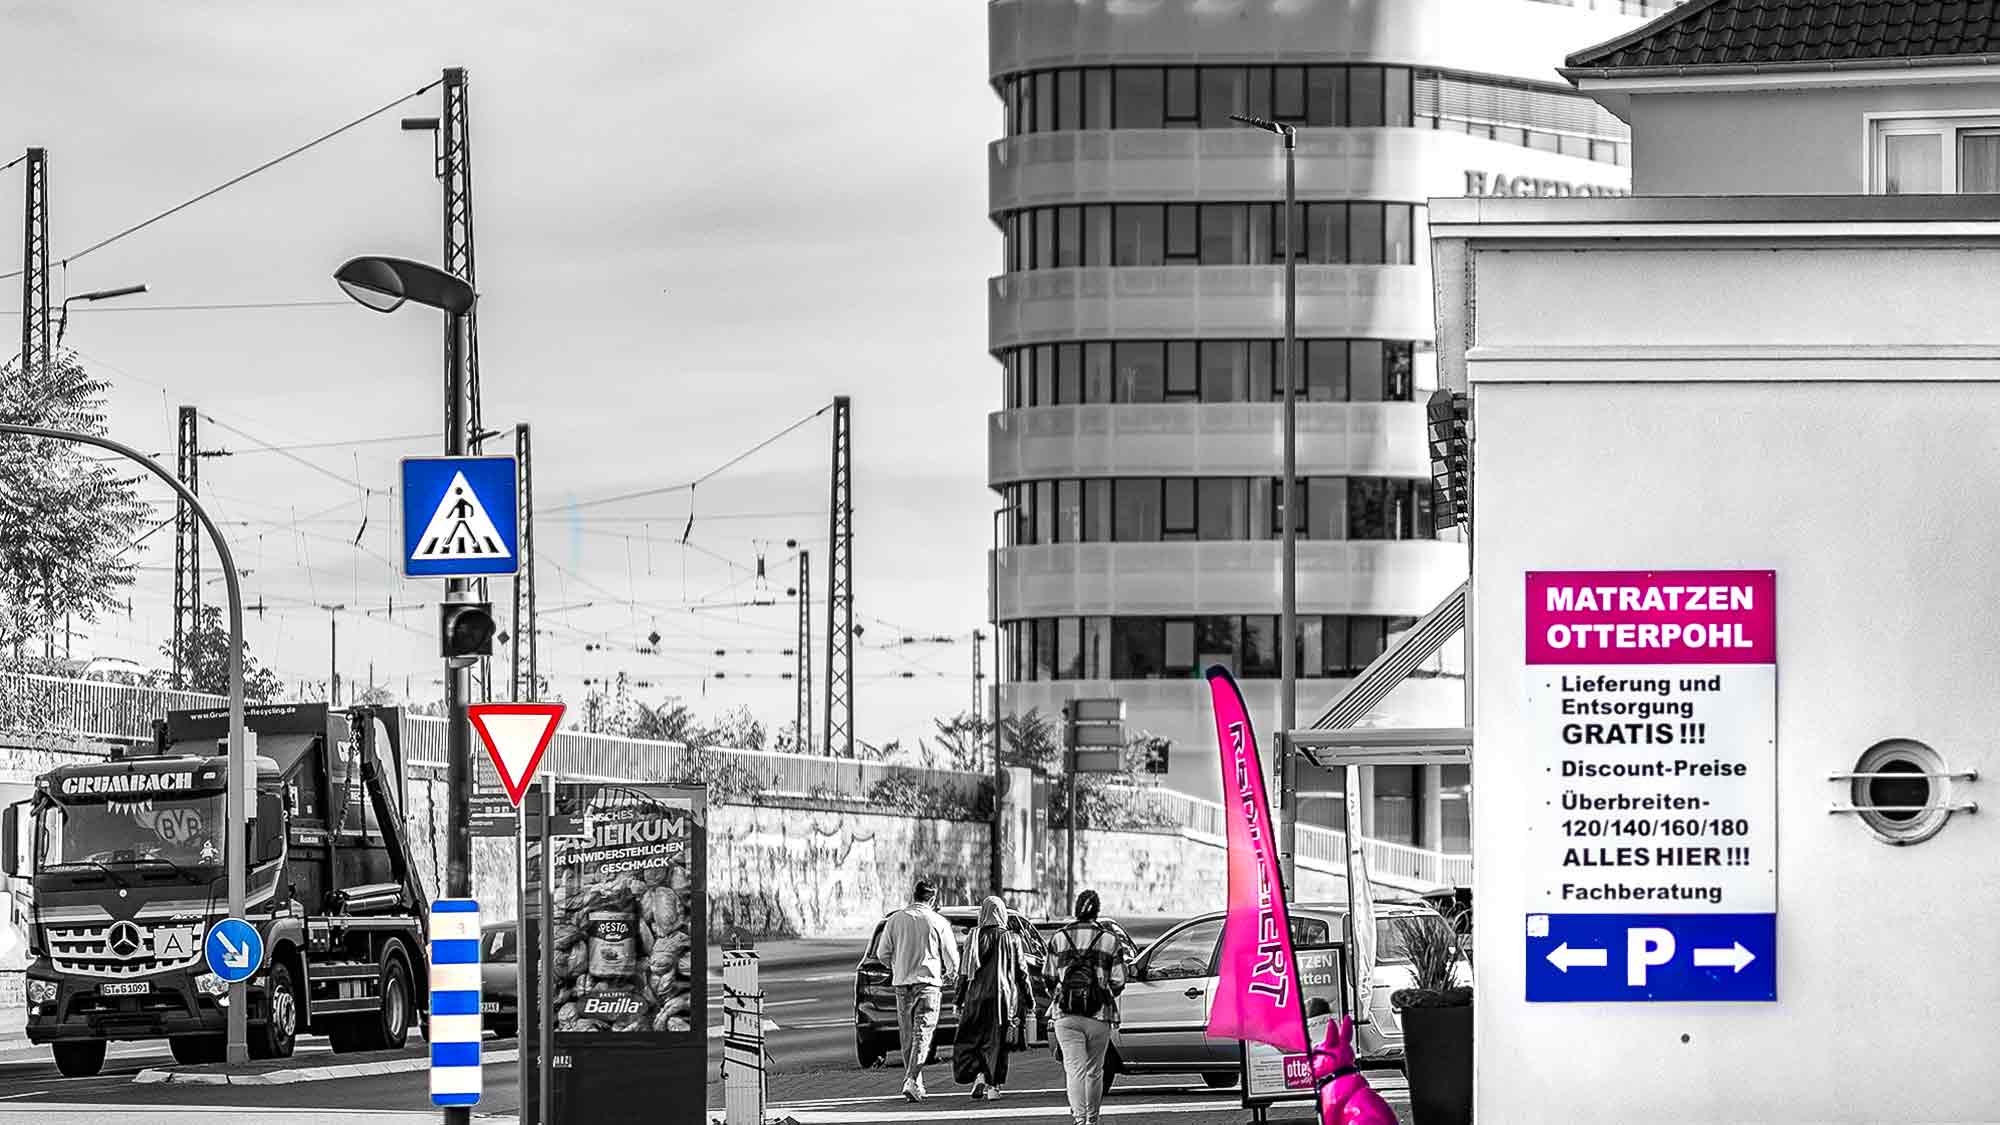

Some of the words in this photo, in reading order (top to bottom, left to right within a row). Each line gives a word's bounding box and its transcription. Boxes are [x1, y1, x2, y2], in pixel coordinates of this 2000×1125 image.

[1546, 586, 1753, 612] MATRATZEN
[1546, 623, 1753, 649] OTTERPOHL
[1562, 675, 1671, 696] Lieferung
[1679, 675, 1721, 692] und
[1562, 699, 1694, 719] Entsorgung
[1562, 723, 1675, 745] GRATIS
[1680, 723, 1705, 745] !!!
[1562, 760, 1747, 777] Discount-Preise
[62, 772, 193, 794] GRUMBACH
[1562, 790, 1710, 810] Überbreiten-
[1562, 819, 1749, 837] 120/140/160/180
[568, 842, 684, 864] UNWIDERSTEHLICHEN
[1562, 847, 1650, 866] ALLES
[1656, 847, 1721, 866] HIER
[1726, 847, 1750, 866] !!!
[1562, 883, 1723, 904] Fachberatung
[600, 922, 626, 934] PESTO
[164, 932, 184, 953] A
[1297, 954, 1332, 968] TZEN
[1628, 927, 1676, 986] P
[584, 998, 640, 1013] Barilla
